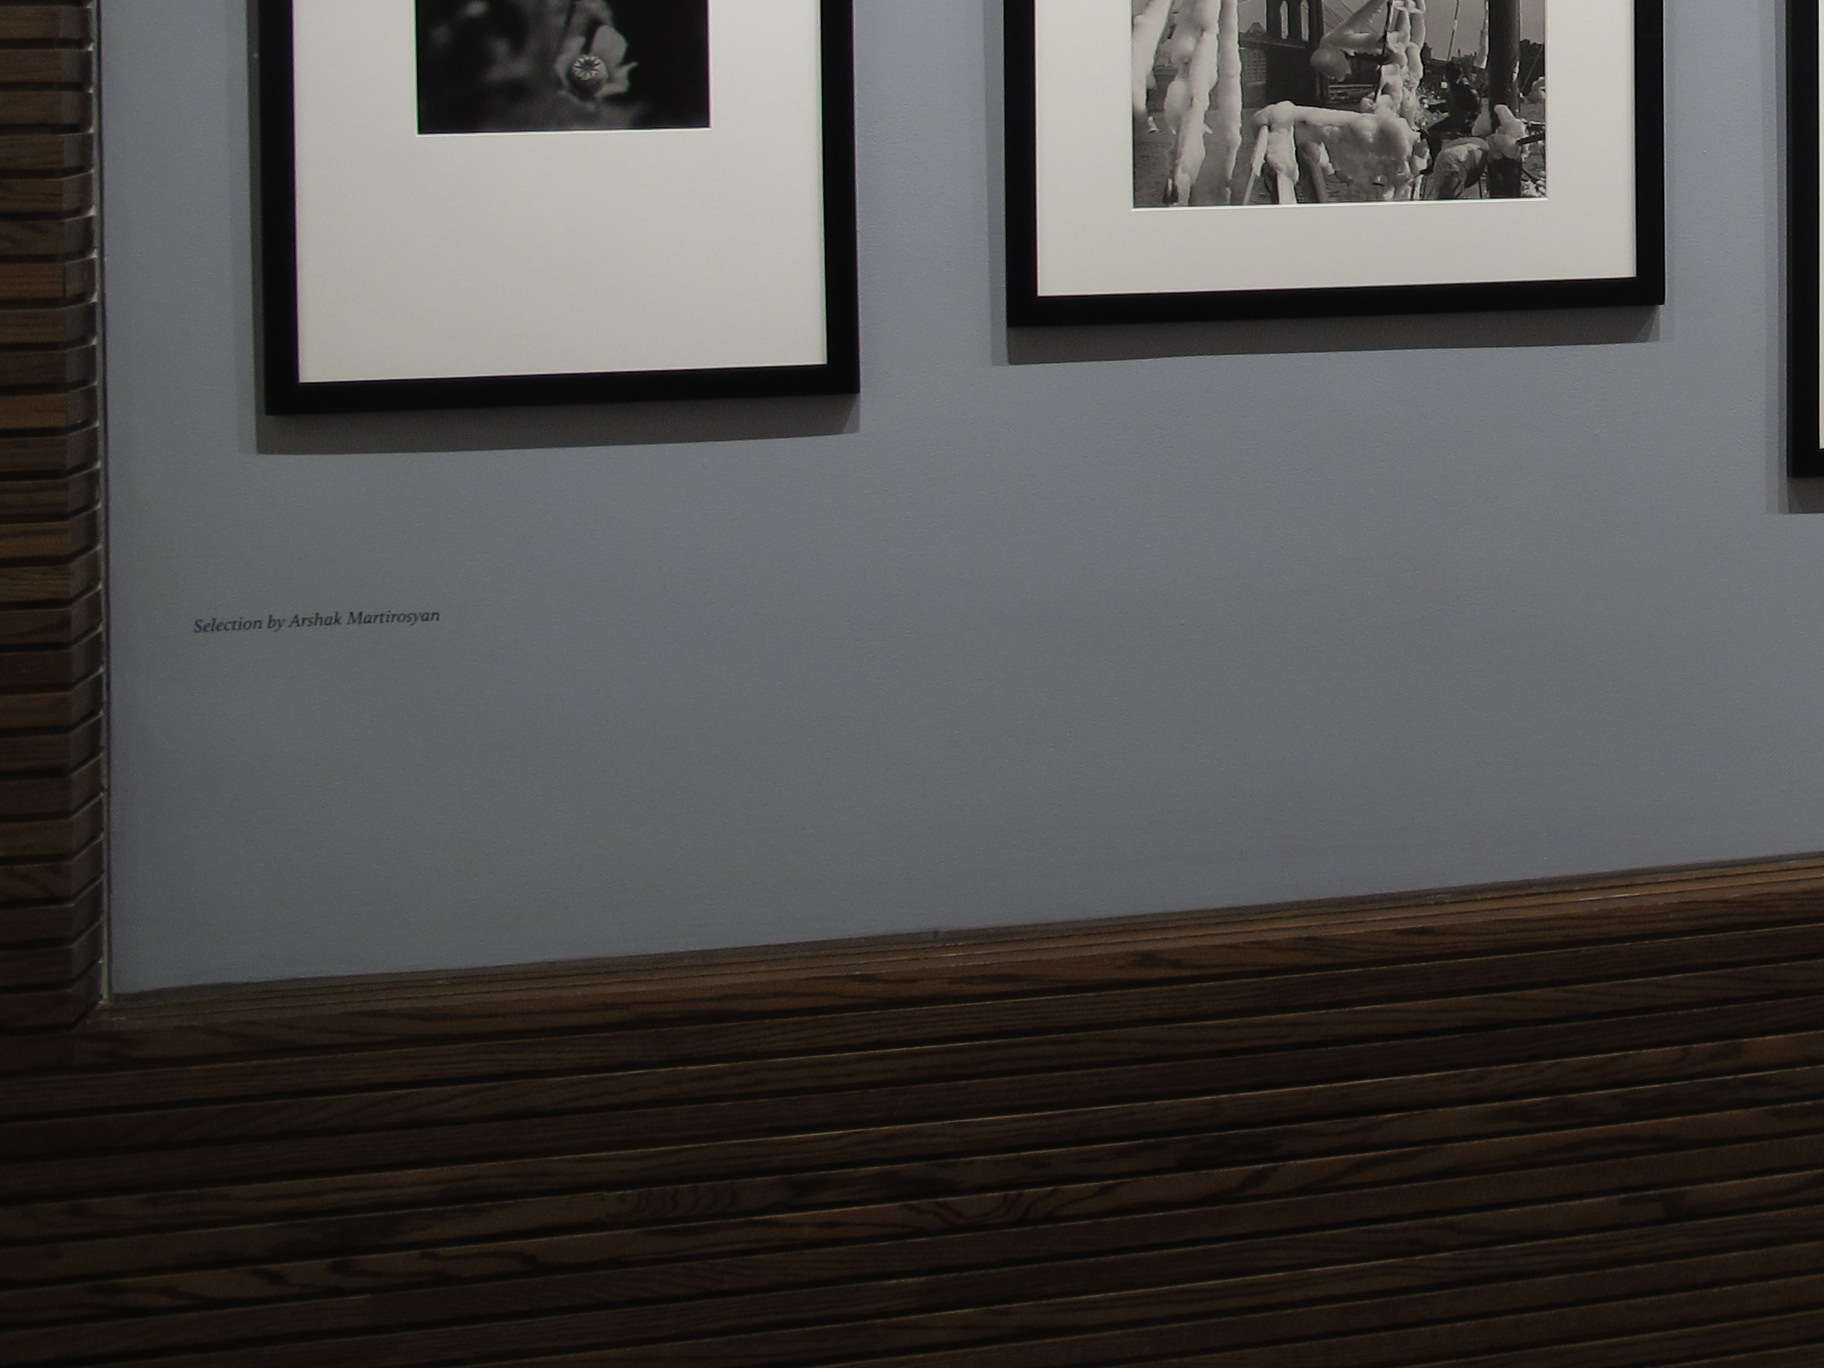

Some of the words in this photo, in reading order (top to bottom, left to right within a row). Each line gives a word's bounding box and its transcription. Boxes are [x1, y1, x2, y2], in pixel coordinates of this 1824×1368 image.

[193, 616, 262, 633] Selection
[267, 614, 285, 632] by
[288, 611, 342, 628] Arshak
[346, 609, 440, 626] Martirosyan
